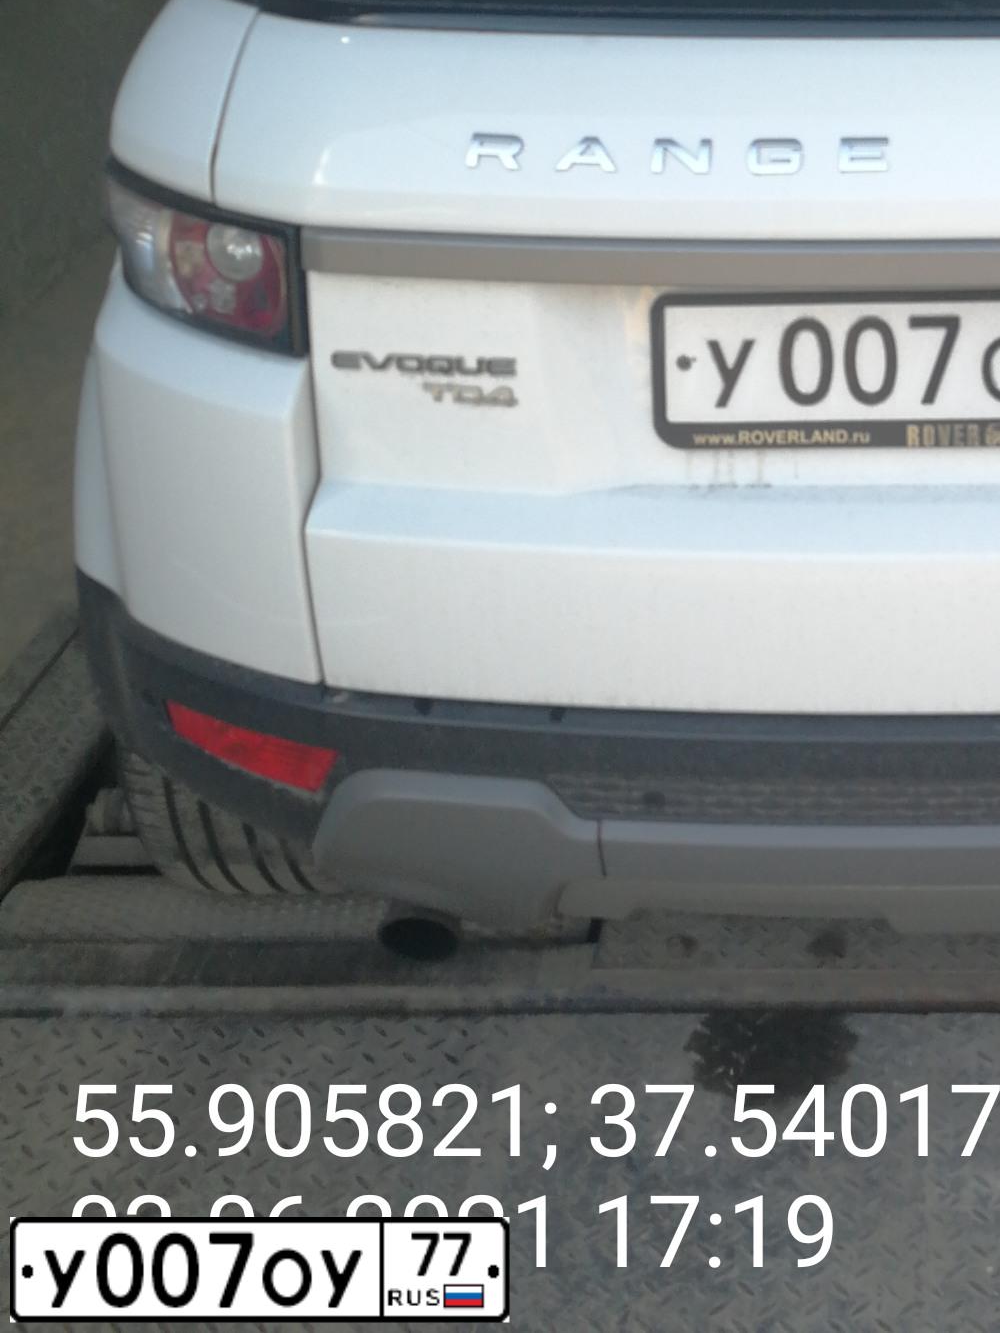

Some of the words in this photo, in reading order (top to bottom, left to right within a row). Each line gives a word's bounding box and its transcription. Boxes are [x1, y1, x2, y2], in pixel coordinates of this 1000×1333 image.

[464, 132, 890, 175] RANGE
[331, 350, 517, 377] EVOQUE
[693, 429, 870, 446] www.ROVERLAND.ru
[906, 423, 979, 447] ROVER
